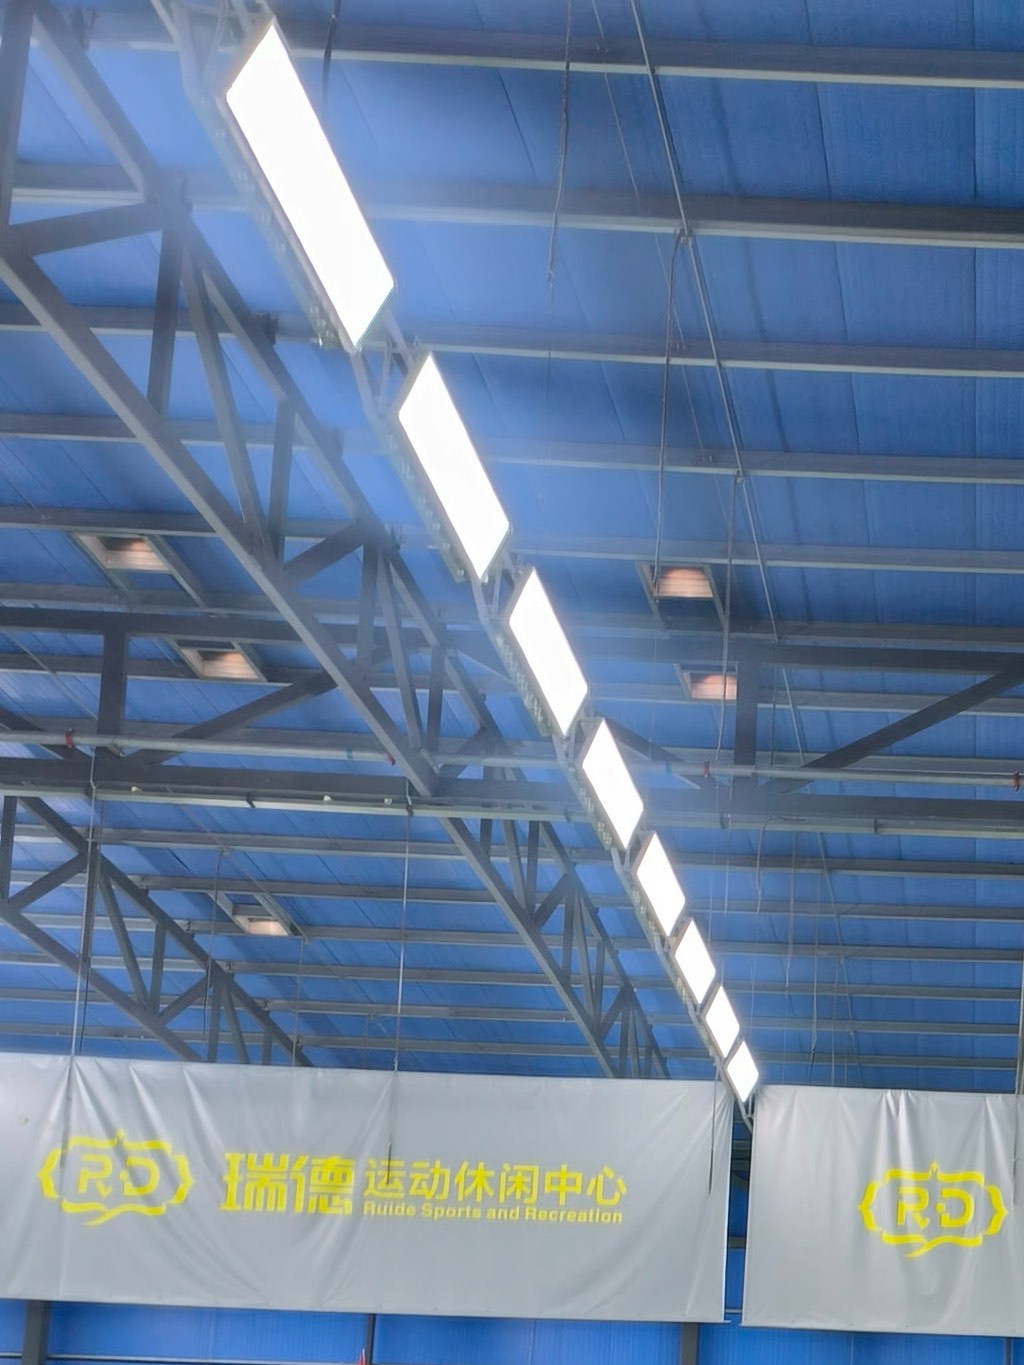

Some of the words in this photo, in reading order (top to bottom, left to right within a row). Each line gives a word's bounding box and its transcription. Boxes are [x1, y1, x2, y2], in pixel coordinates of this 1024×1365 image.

[219, 1153, 355, 1215] 瑞德
[363, 1158, 628, 1207] 运动休闲中心
[363, 1201, 416, 1217] Ruide
[421, 1202, 481, 1220] Sports
[486, 1206, 520, 1221] and
[525, 1206, 623, 1224] Recreation
